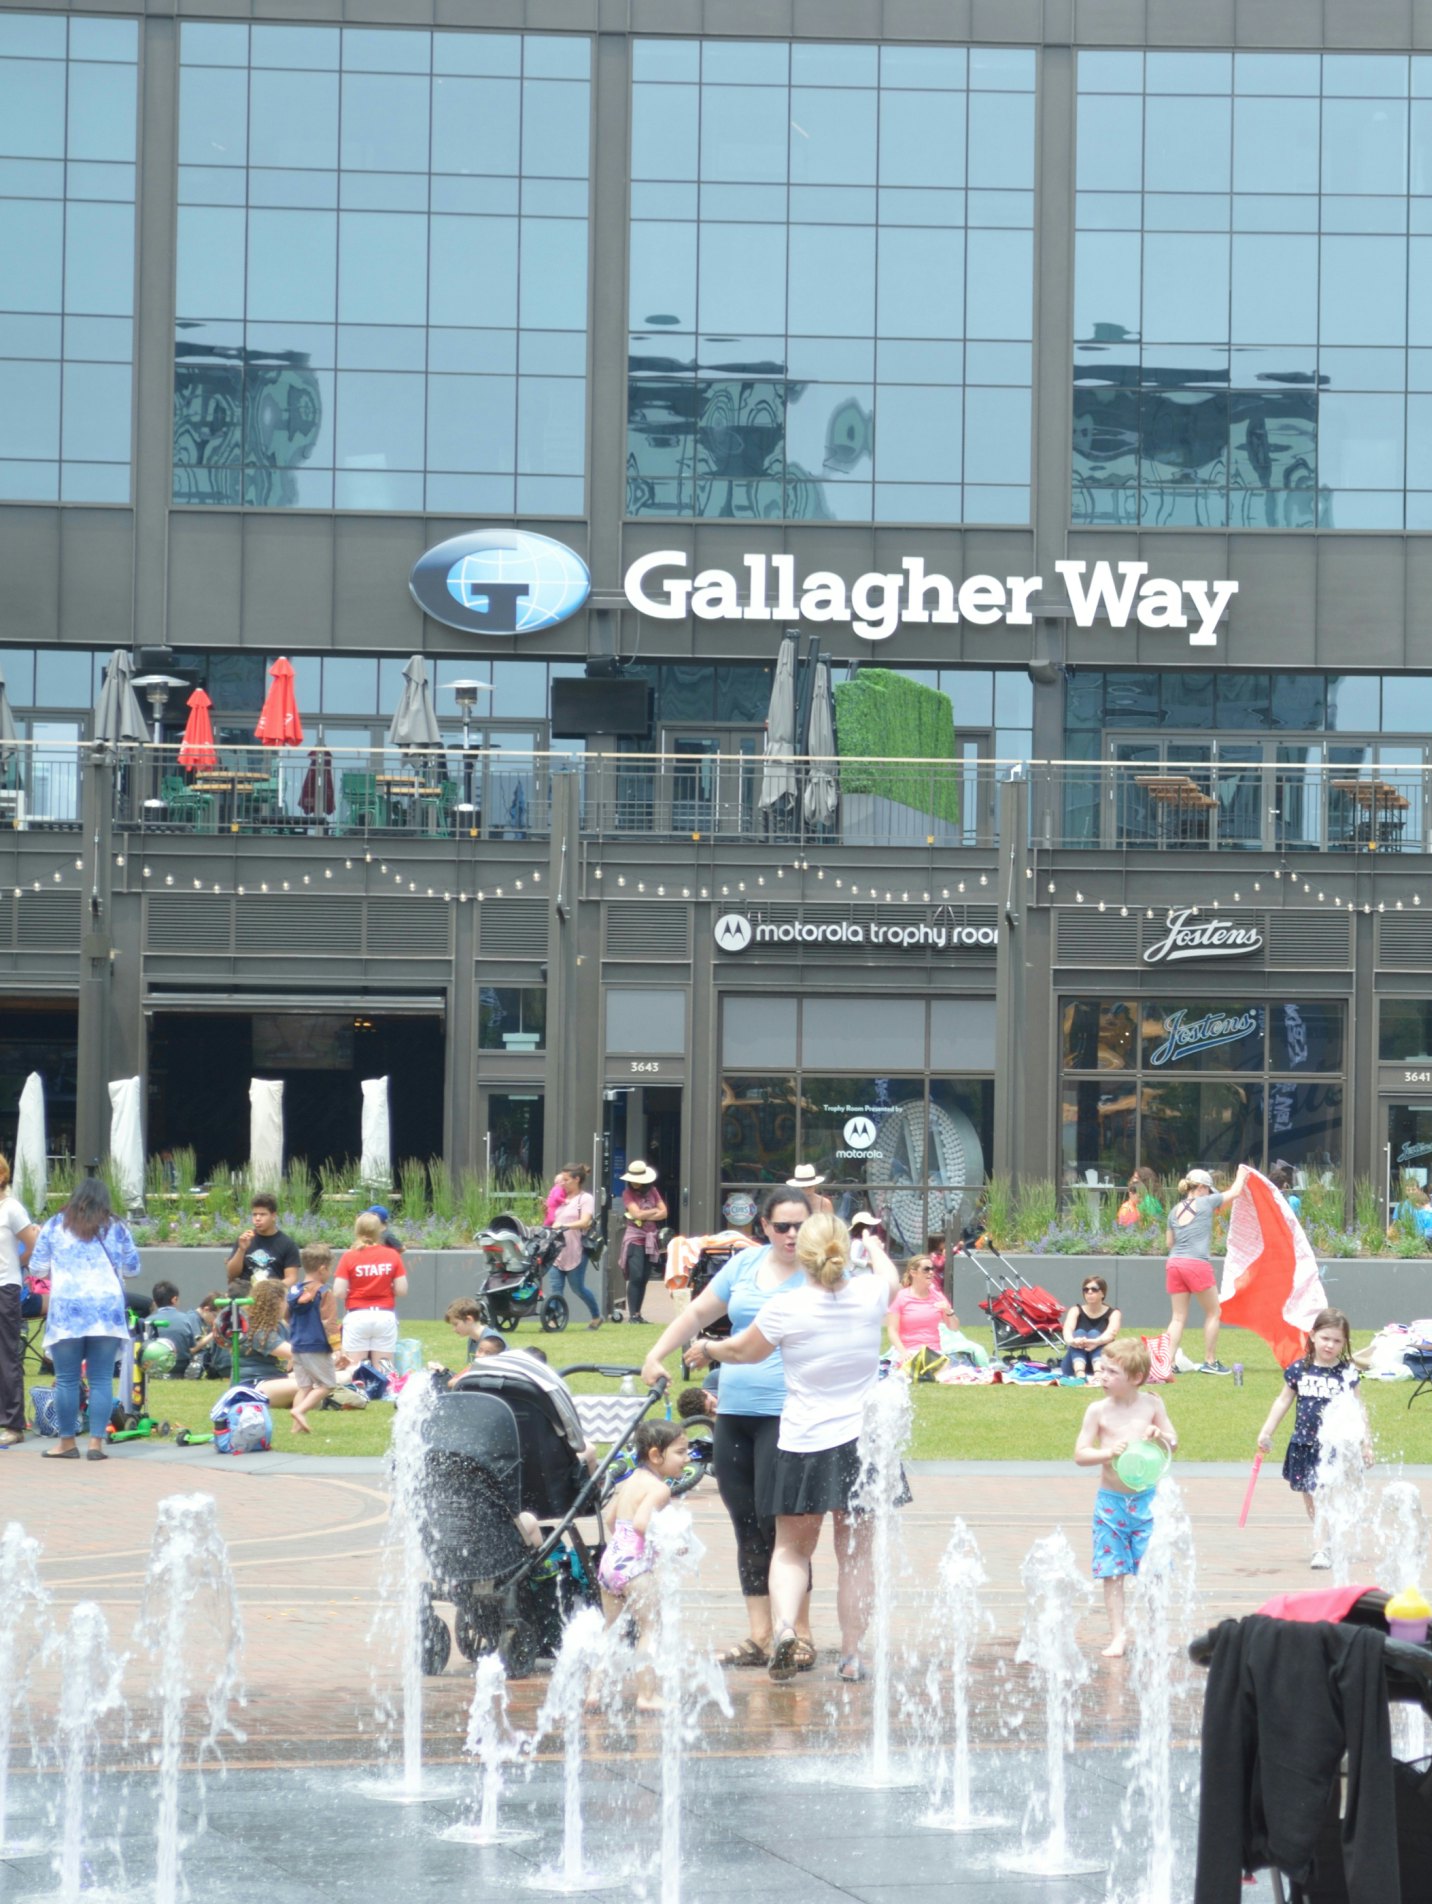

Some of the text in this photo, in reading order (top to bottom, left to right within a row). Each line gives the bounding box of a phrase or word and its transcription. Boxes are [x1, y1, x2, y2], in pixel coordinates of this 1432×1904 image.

[623, 550, 1239, 647] Gallagher Way
[756, 921, 864, 942] motorola
[870, 923, 946, 947] trophy
[1143, 909, 1263, 962] Jostens
[1150, 1008, 1257, 1066] Jostens
[630, 1062, 660, 1072] 3643
[1404, 1071, 1431, 1082] 3641
[823, 1104, 845, 1113] Trophy
[846, 1104, 864, 1112] Room
[864, 1104, 894, 1113] Presented
[835, 1149, 883, 1159] motorola
[355, 1264, 392, 1277] STAFF
[1298, 1375, 1340, 1388] STAR
